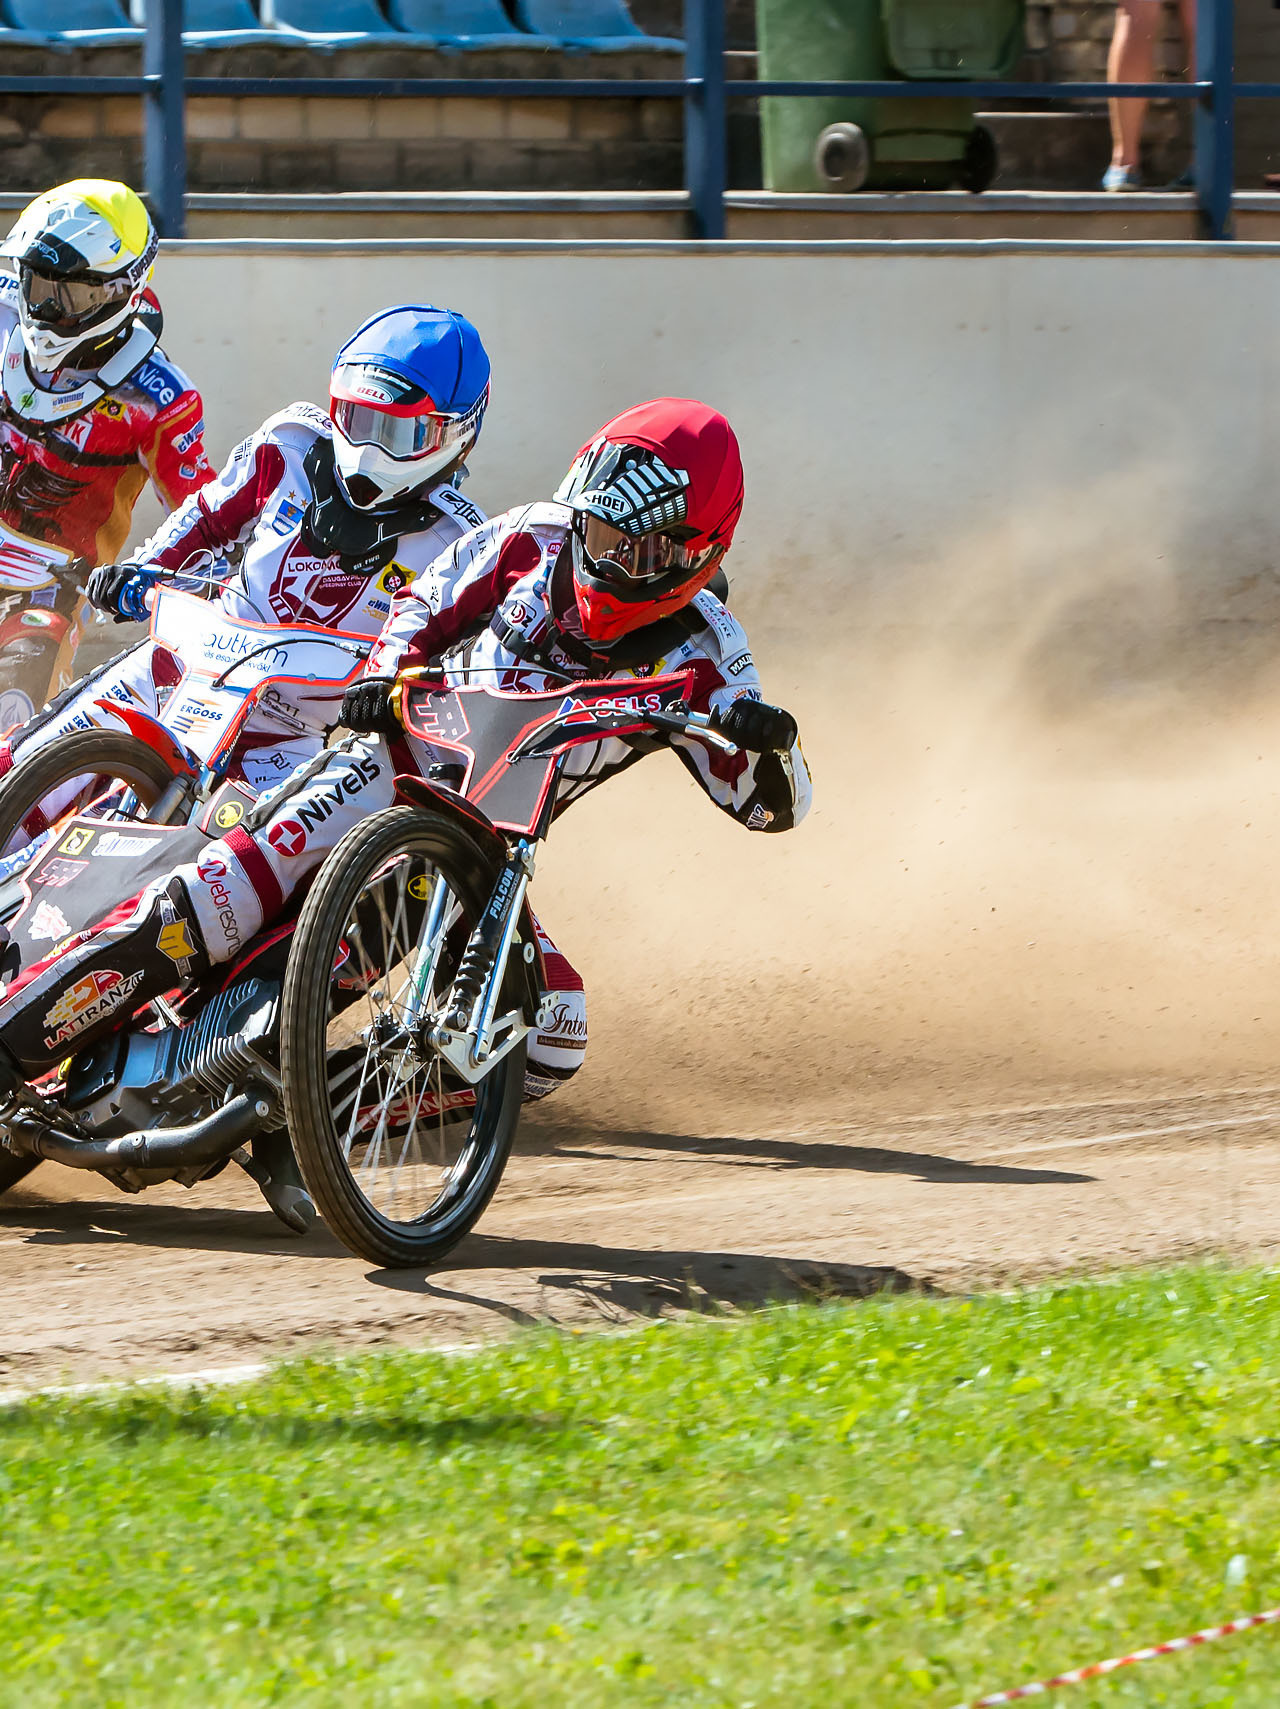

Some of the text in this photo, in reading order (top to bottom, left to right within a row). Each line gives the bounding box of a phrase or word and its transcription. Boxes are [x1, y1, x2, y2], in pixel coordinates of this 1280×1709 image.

[134, 364, 175, 405] Nice
[357, 387, 386, 401] BELL
[180, 704, 223, 721] ERGOSS
[296, 757, 381, 834] Nivels
[489, 867, 515, 919] FALCON
